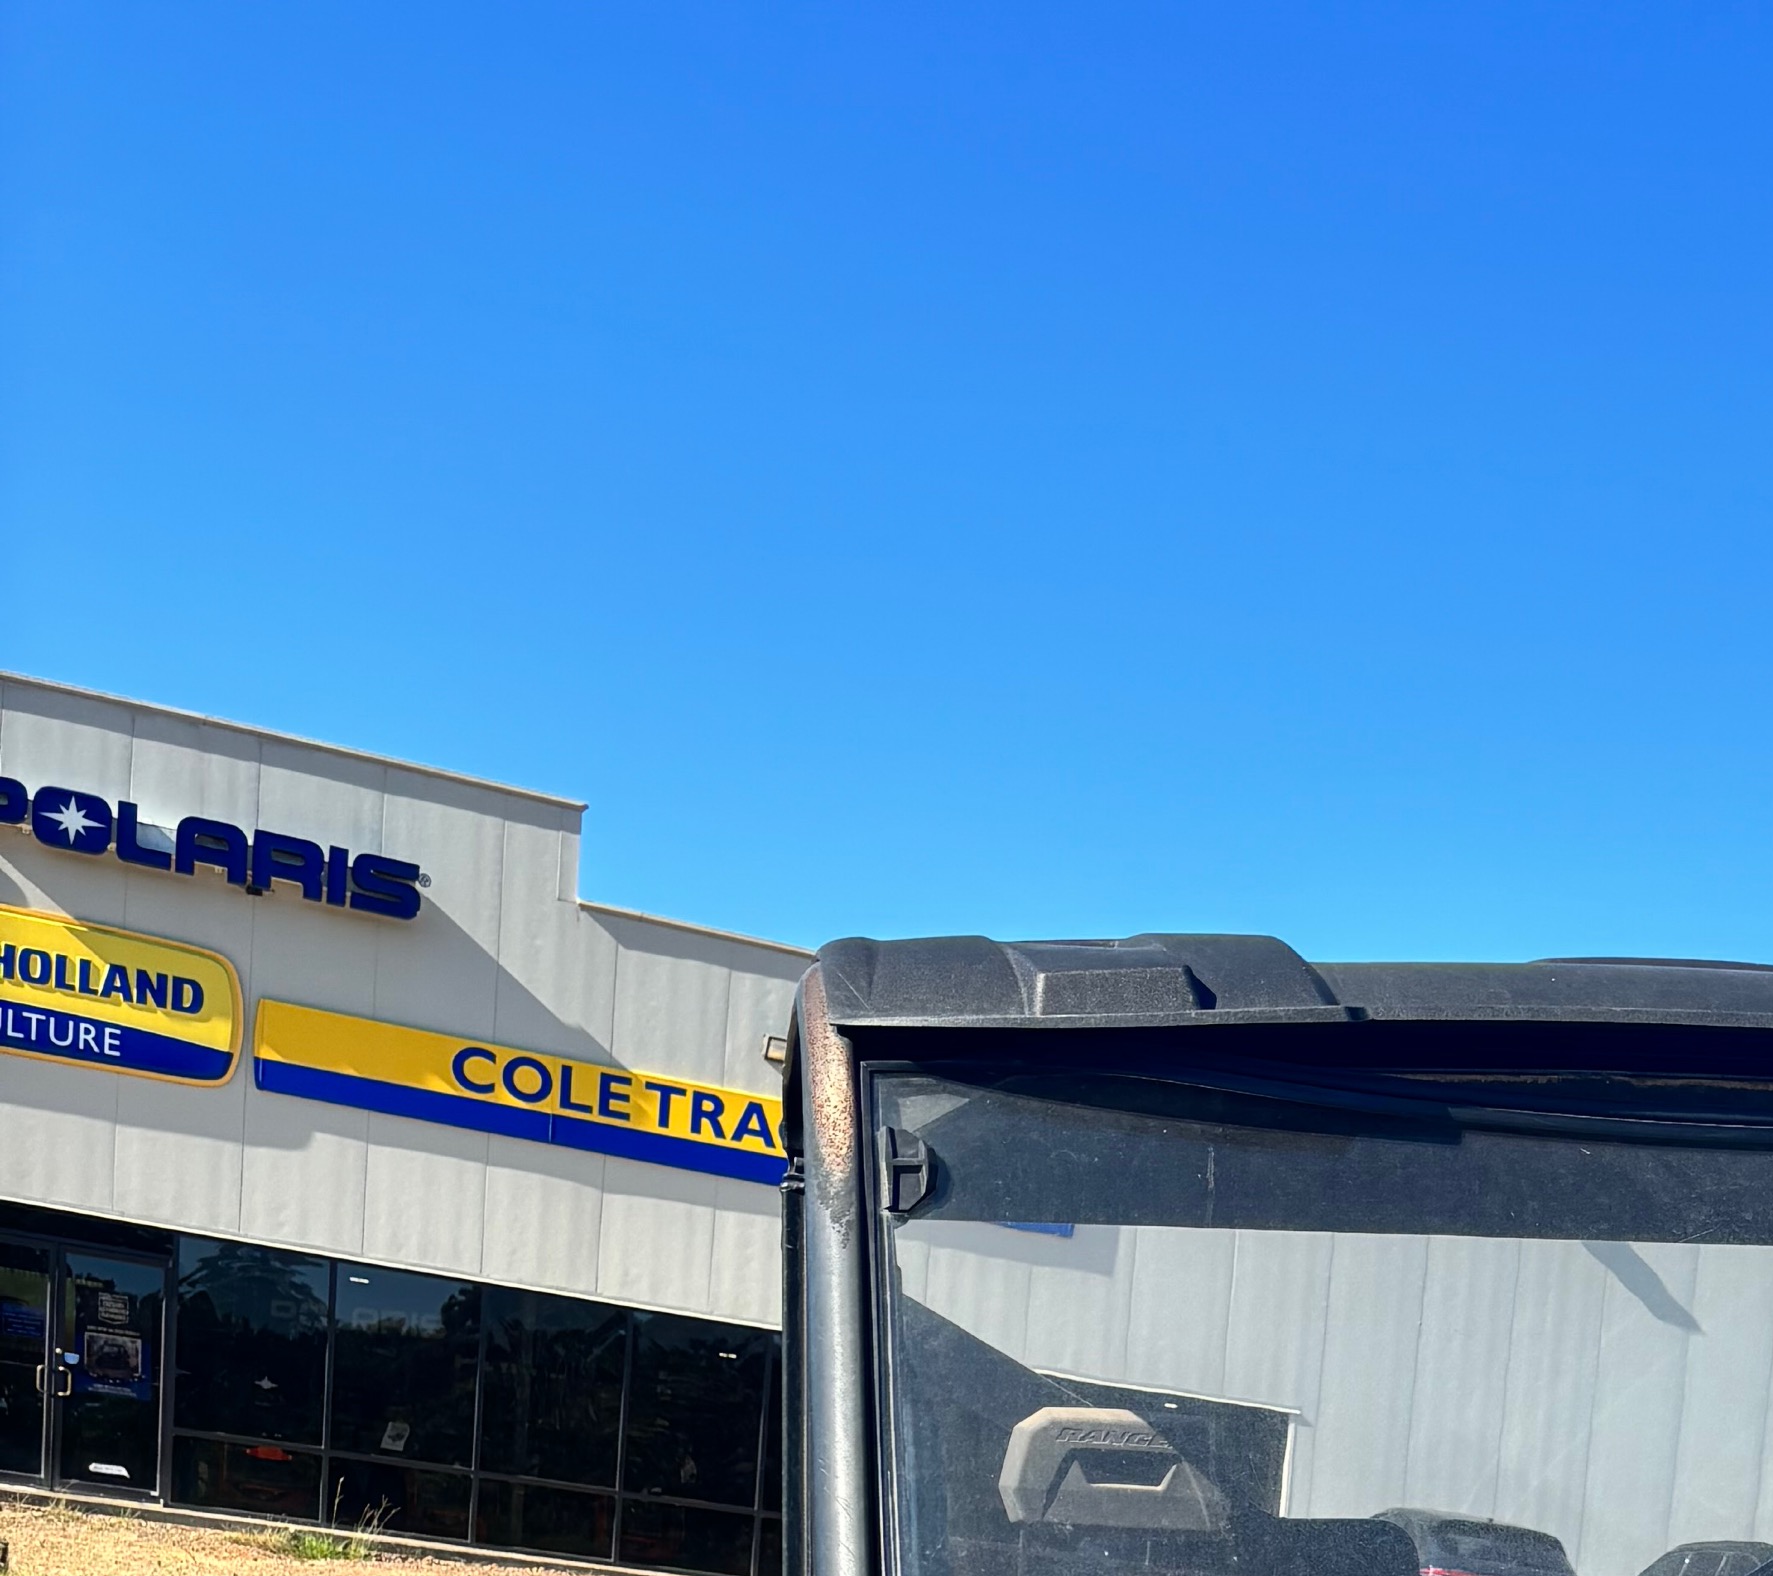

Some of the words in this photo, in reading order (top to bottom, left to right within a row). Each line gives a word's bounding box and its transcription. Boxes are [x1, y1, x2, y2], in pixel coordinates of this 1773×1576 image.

[0, 1007, 121, 1057] LTURE
[452, 1047, 632, 1121] COLE
[1056, 1428, 1173, 1450] RANGE
